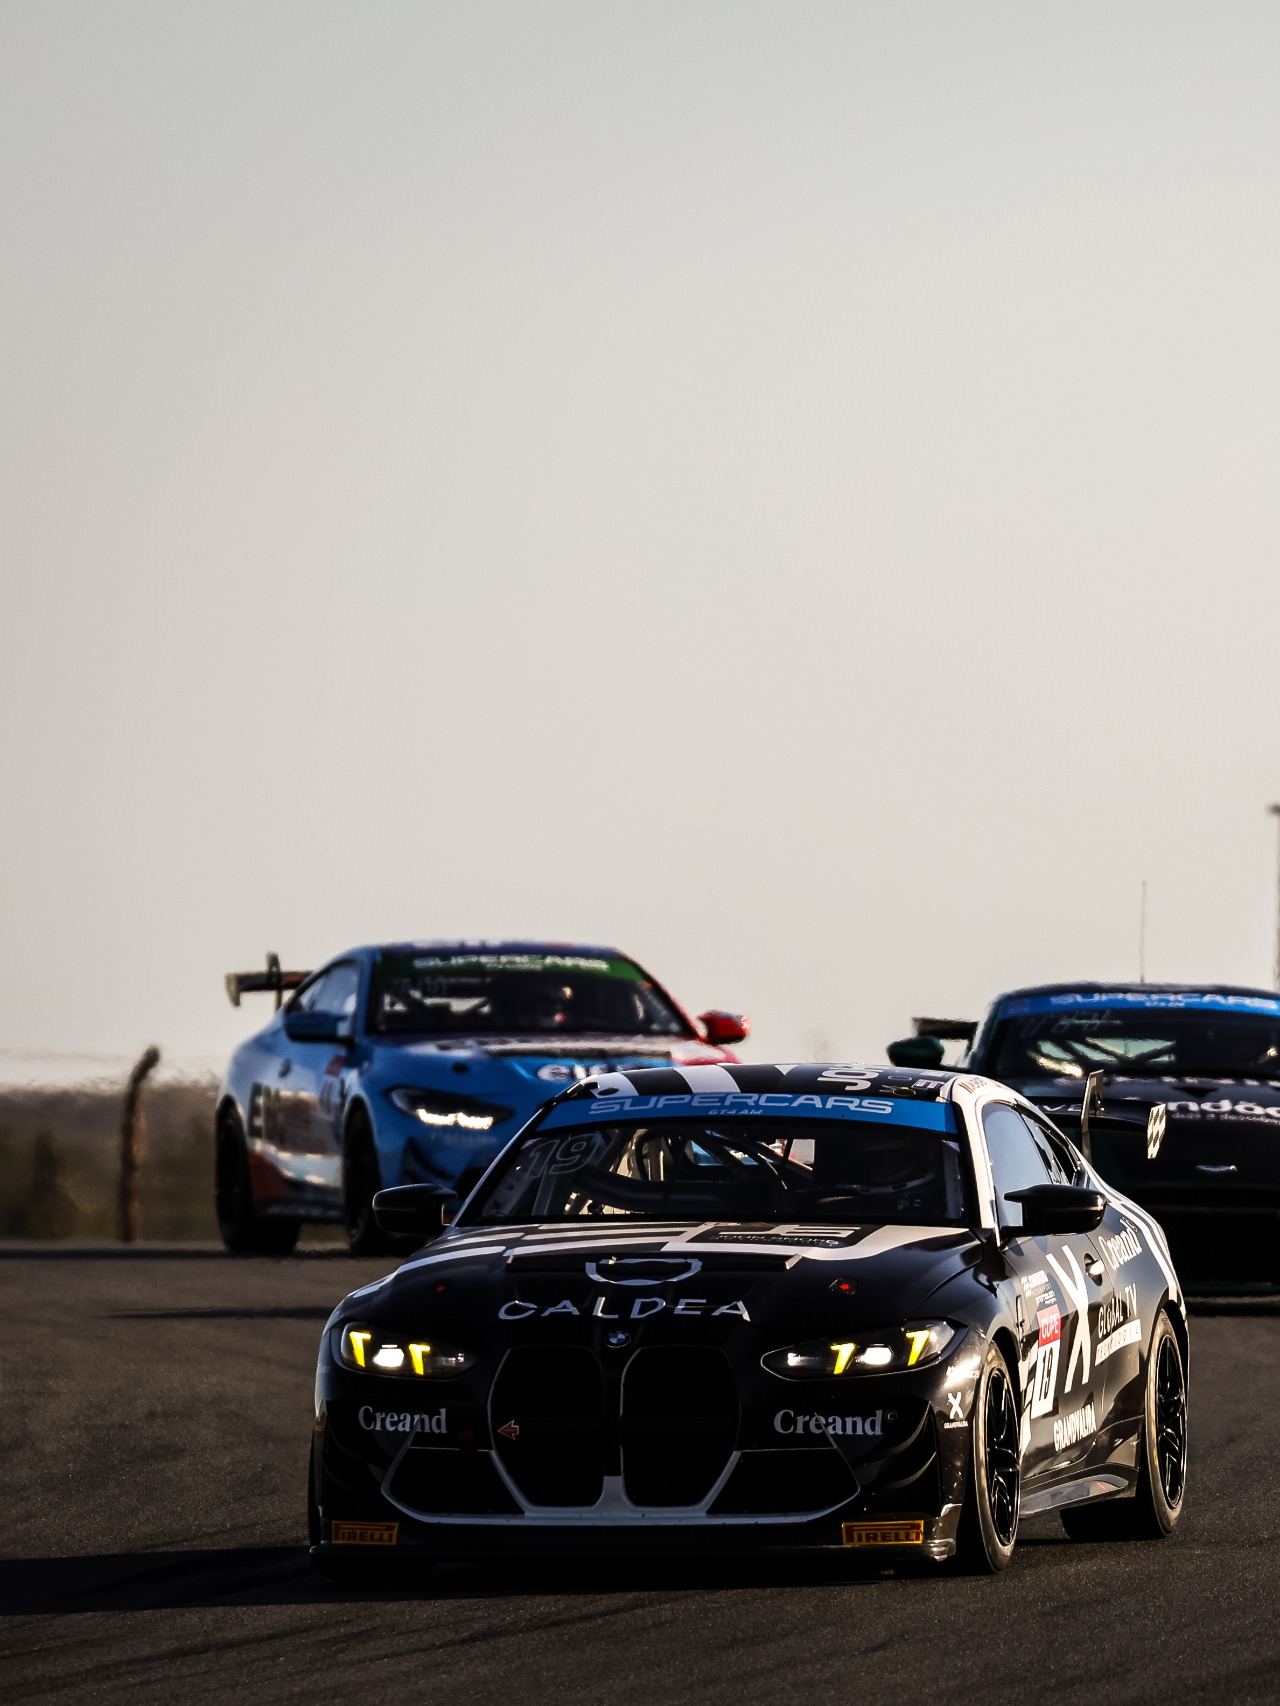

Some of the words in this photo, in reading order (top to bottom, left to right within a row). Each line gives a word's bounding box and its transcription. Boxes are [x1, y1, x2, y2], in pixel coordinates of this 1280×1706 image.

[1050, 992, 1279, 1010] SUPERCARS
[588, 1092, 896, 1115] SUPERCARS
[708, 1108, 737, 1116] GT4
[738, 1108, 764, 1116] AM
[525, 1133, 602, 1179] 19
[1098, 1217, 1144, 1270] Creand
[497, 1296, 751, 1322] CALDEA
[1124, 1282, 1137, 1318] TV
[1038, 1347, 1054, 1402] 19
[357, 1405, 448, 1434] Creand
[773, 1408, 883, 1436] Creand
[333, 1521, 397, 1543] PIRELLI
[844, 1522, 922, 1543] PIRELLI
